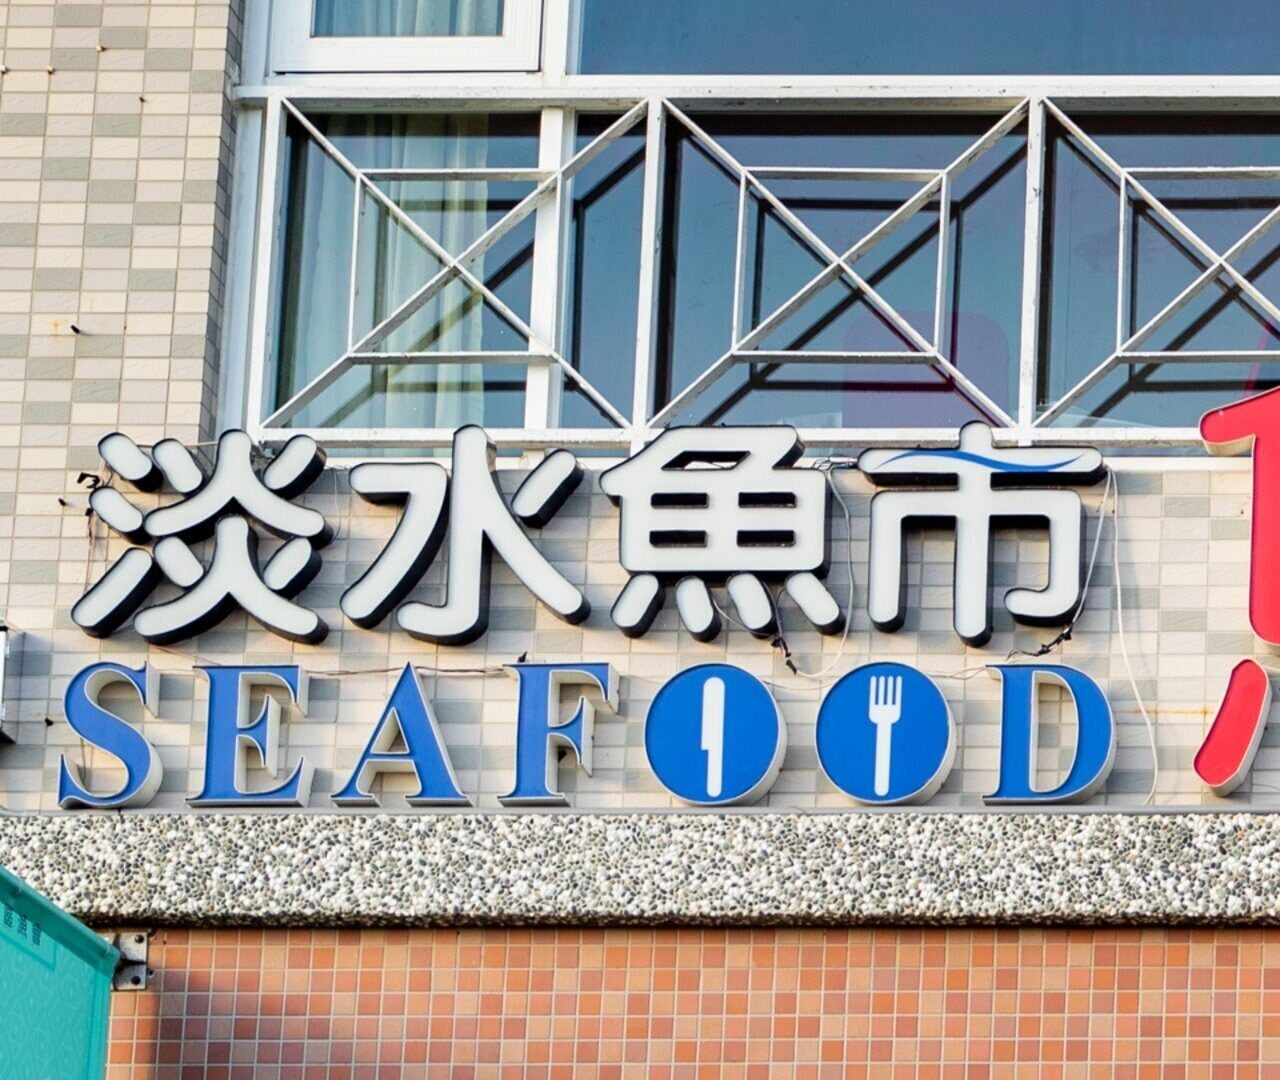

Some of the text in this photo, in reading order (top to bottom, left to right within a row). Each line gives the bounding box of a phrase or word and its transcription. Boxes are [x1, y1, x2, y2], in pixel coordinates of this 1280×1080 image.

[70, 421, 1108, 647] 淡水魚市
[60, 660, 1117, 808] SEAFOOD
